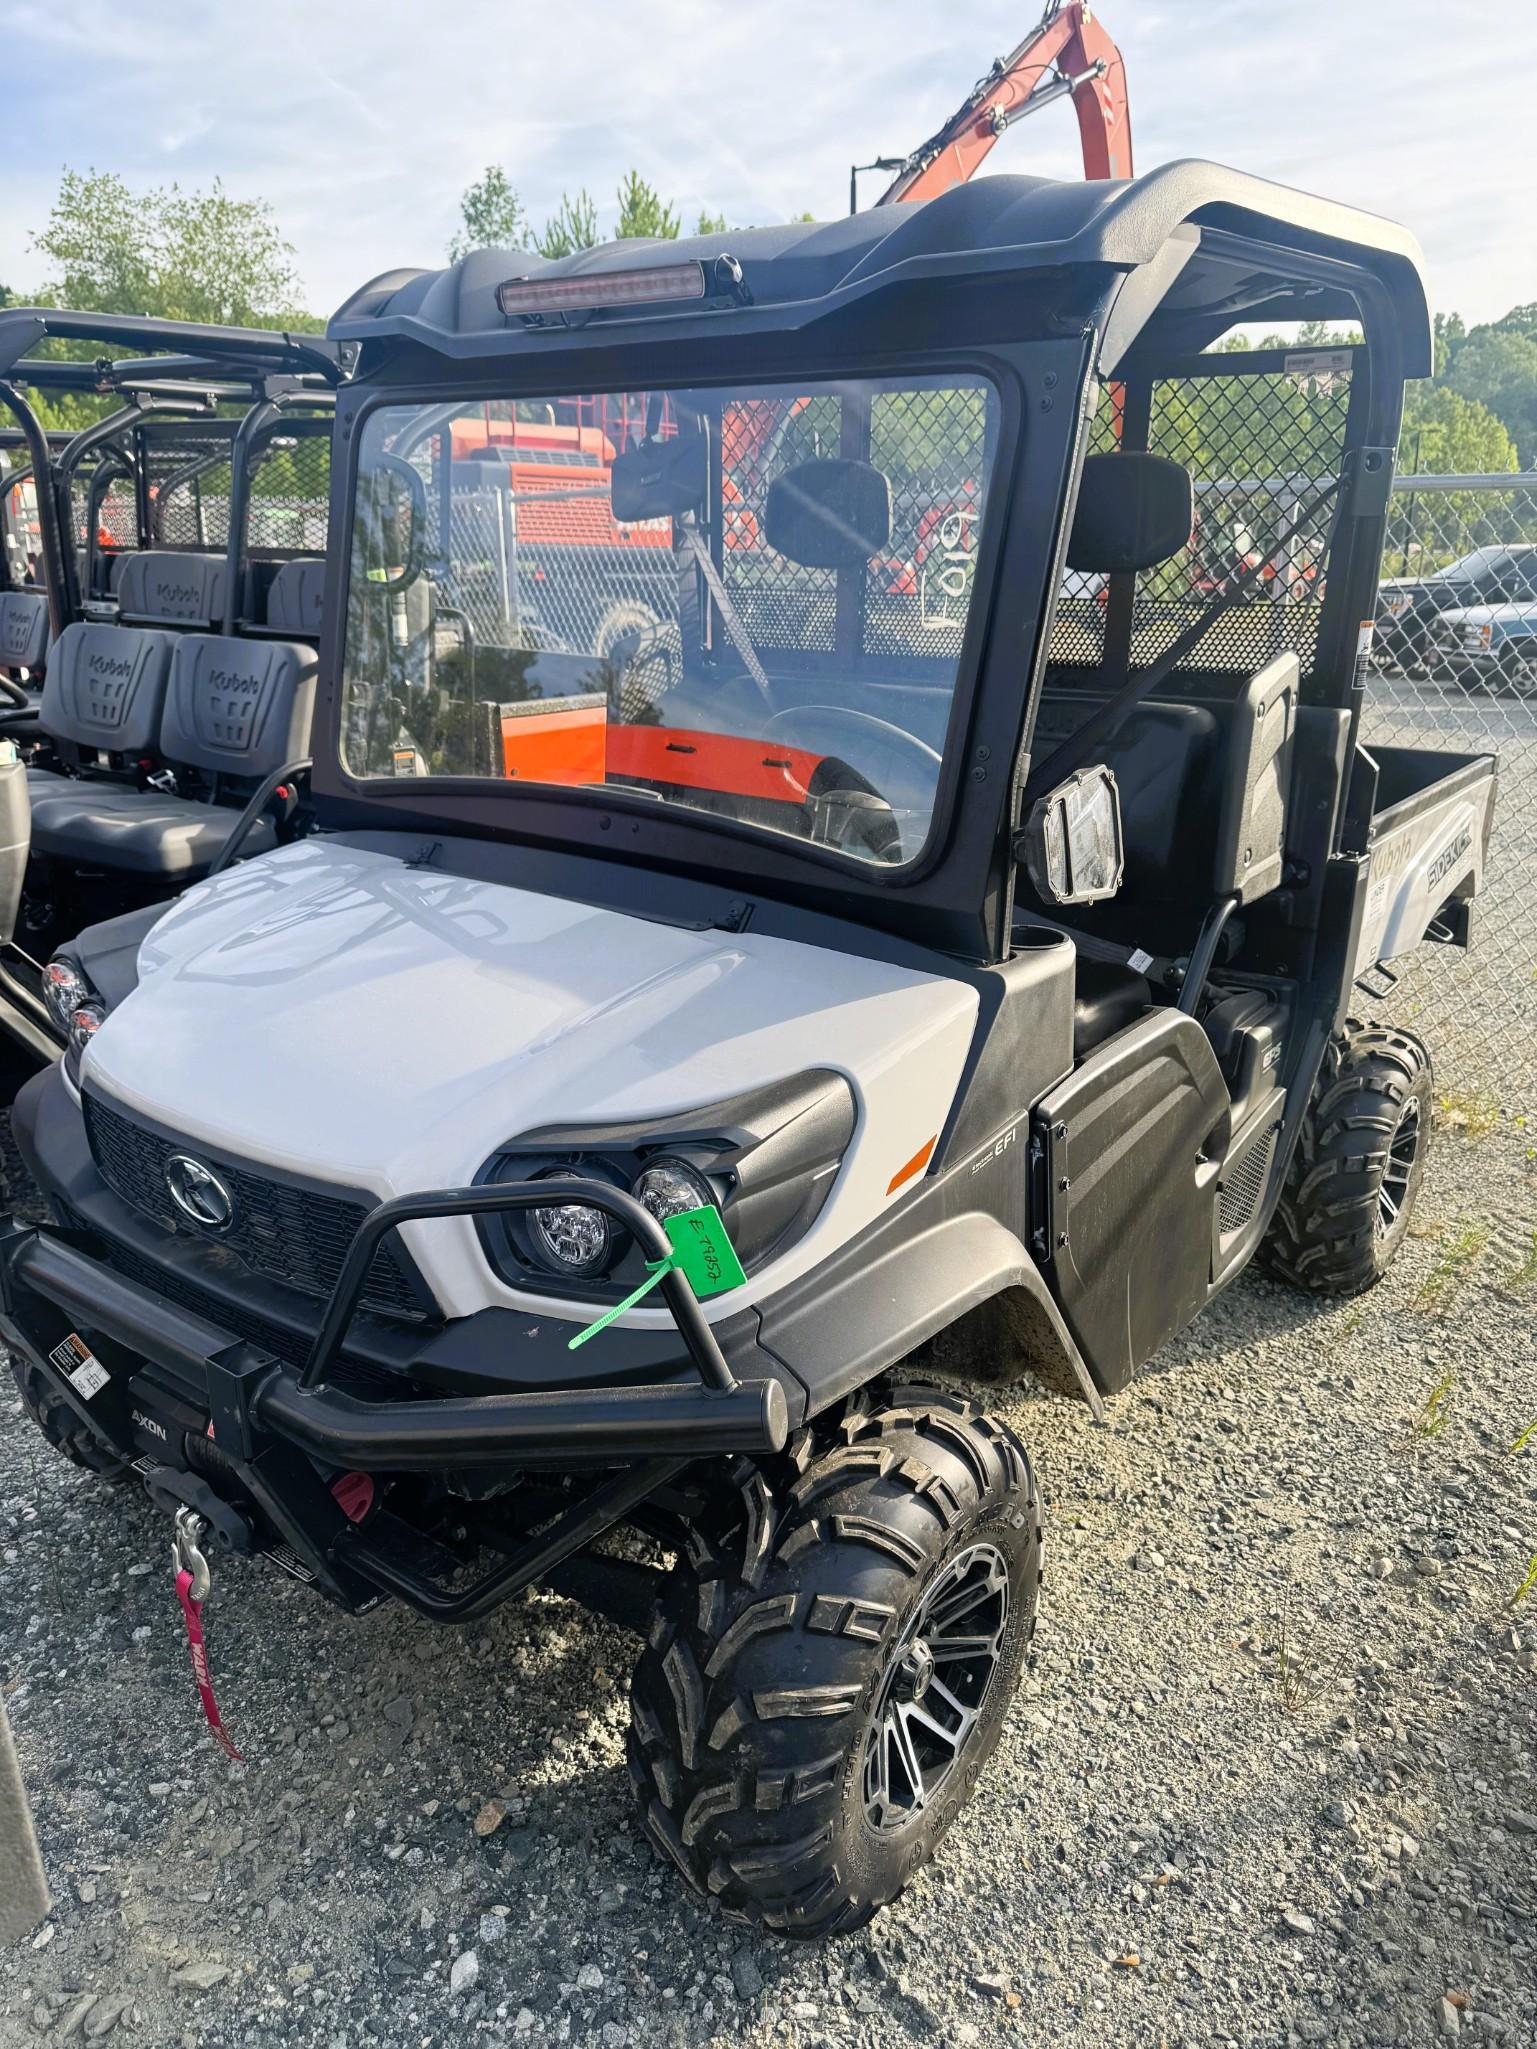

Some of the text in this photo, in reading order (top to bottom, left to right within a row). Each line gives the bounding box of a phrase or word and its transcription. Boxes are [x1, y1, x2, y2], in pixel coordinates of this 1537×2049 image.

[89, 654, 131, 677] Kubota
[208, 669, 259, 695] Kubota
[995, 1128, 1016, 1156] EFI
[132, 1409, 167, 1440] AXON
[191, 1642, 209, 1688] WARN
